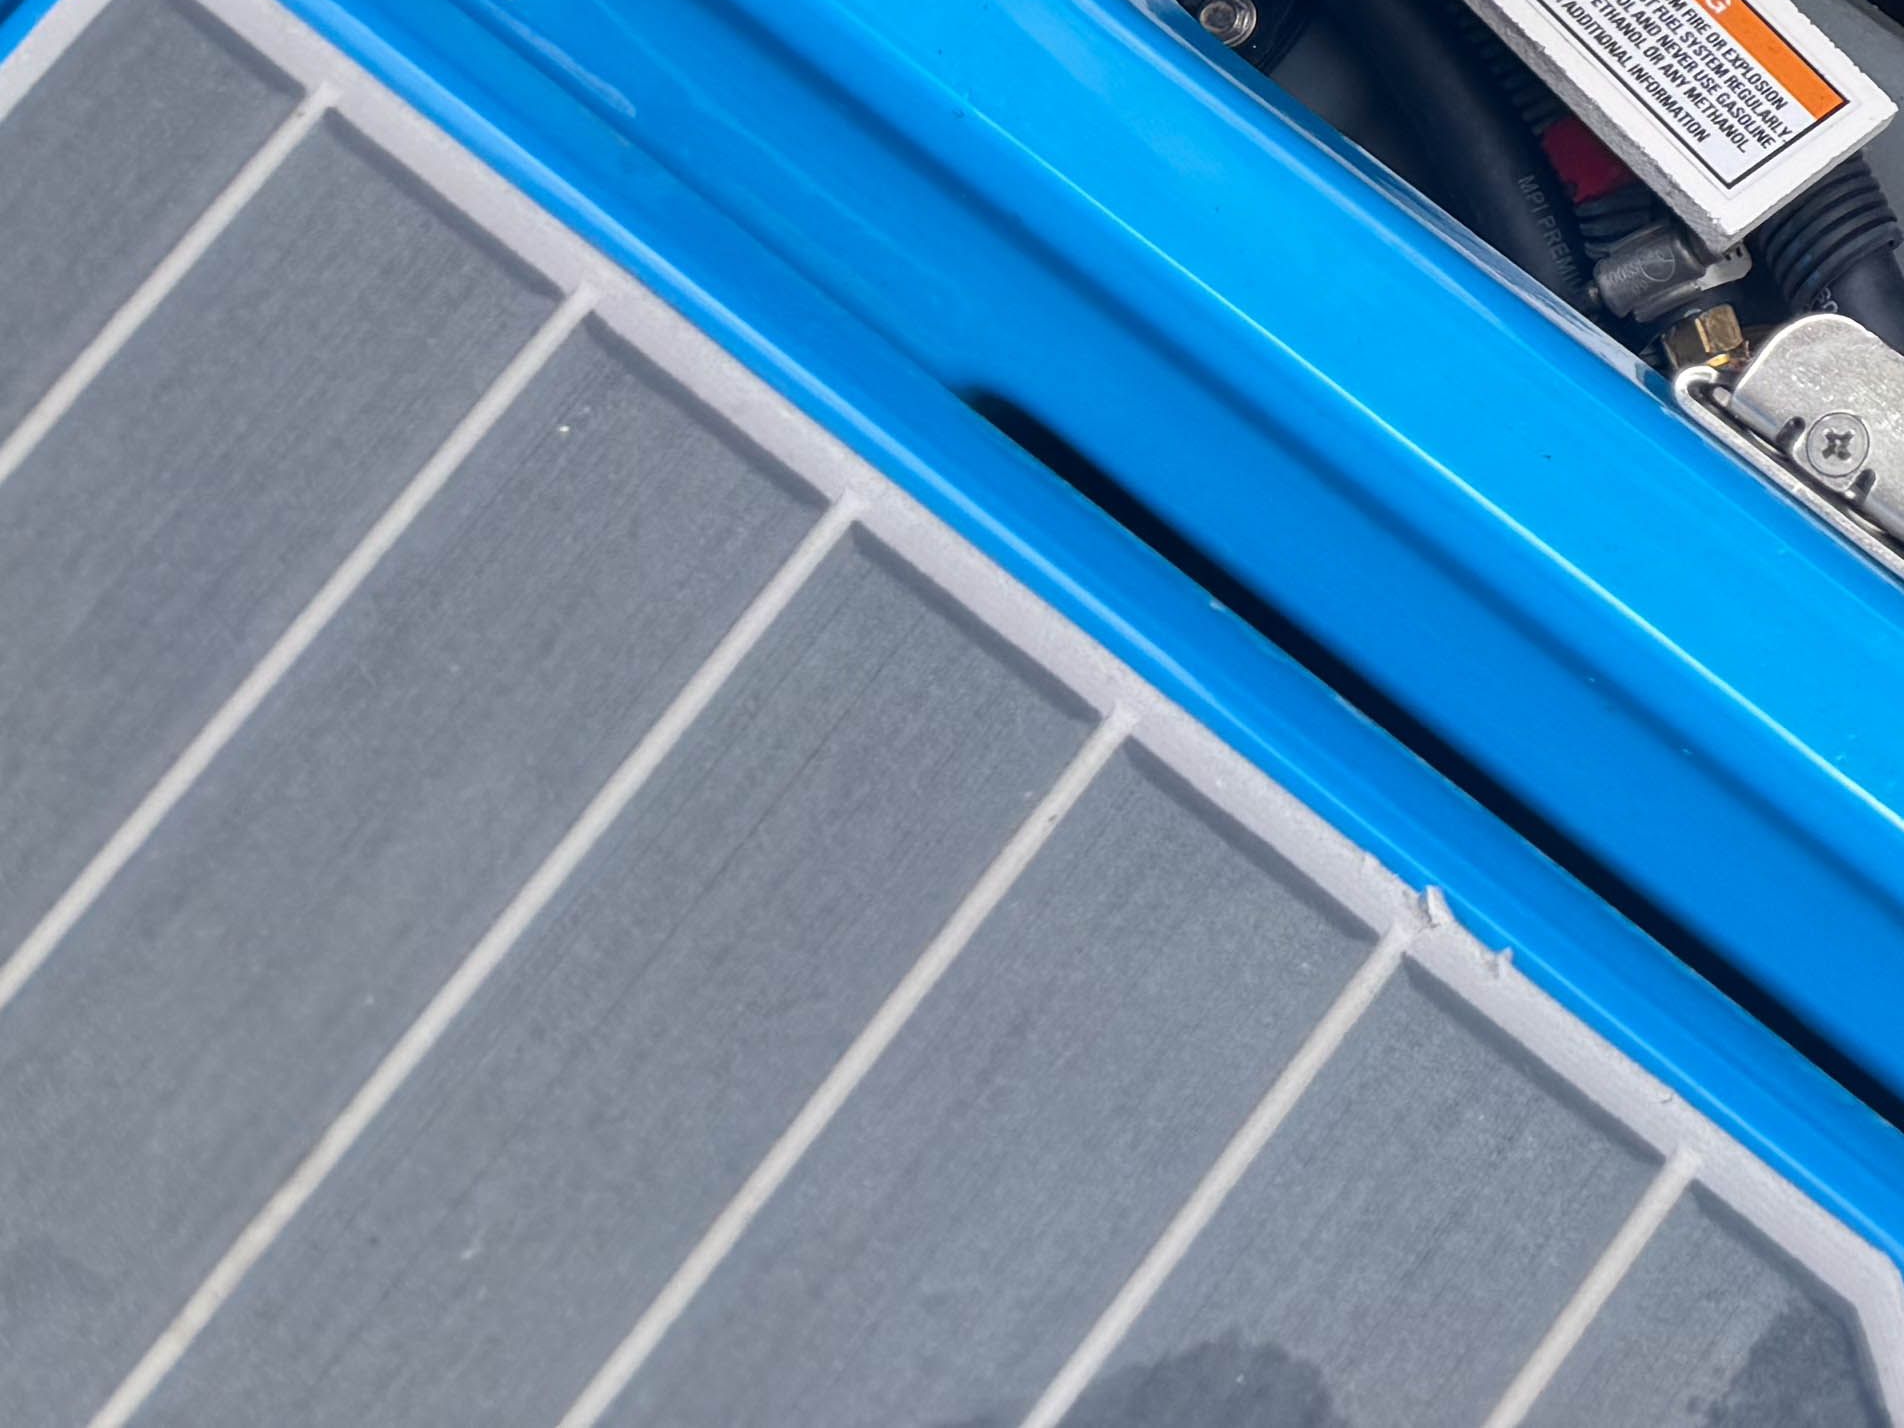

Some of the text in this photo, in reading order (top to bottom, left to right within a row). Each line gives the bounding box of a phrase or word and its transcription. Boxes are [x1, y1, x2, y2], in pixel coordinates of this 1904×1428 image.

[1561, 1, 1633, 68] ADDITIONAL
[1627, 64, 1711, 143] INFORMATION
[1631, 11, 1662, 43] AND
[1656, 34, 1699, 73] NEVER
[1693, 69, 1722, 96] USE
[1715, 92, 1776, 149] GASOLINE
[1643, 46, 1665, 65] OR
[1658, 63, 1691, 88] ANY
[1652, 5, 1684, 35] FUEL
[1679, 31, 1730, 78] SYSTEM
[1723, 75, 1793, 145] REGULARLY.
[1681, 8, 1711, 35] FIRE
[1705, 32, 1727, 51] OR
[1721, 48, 1788, 111] EXPLOSION
